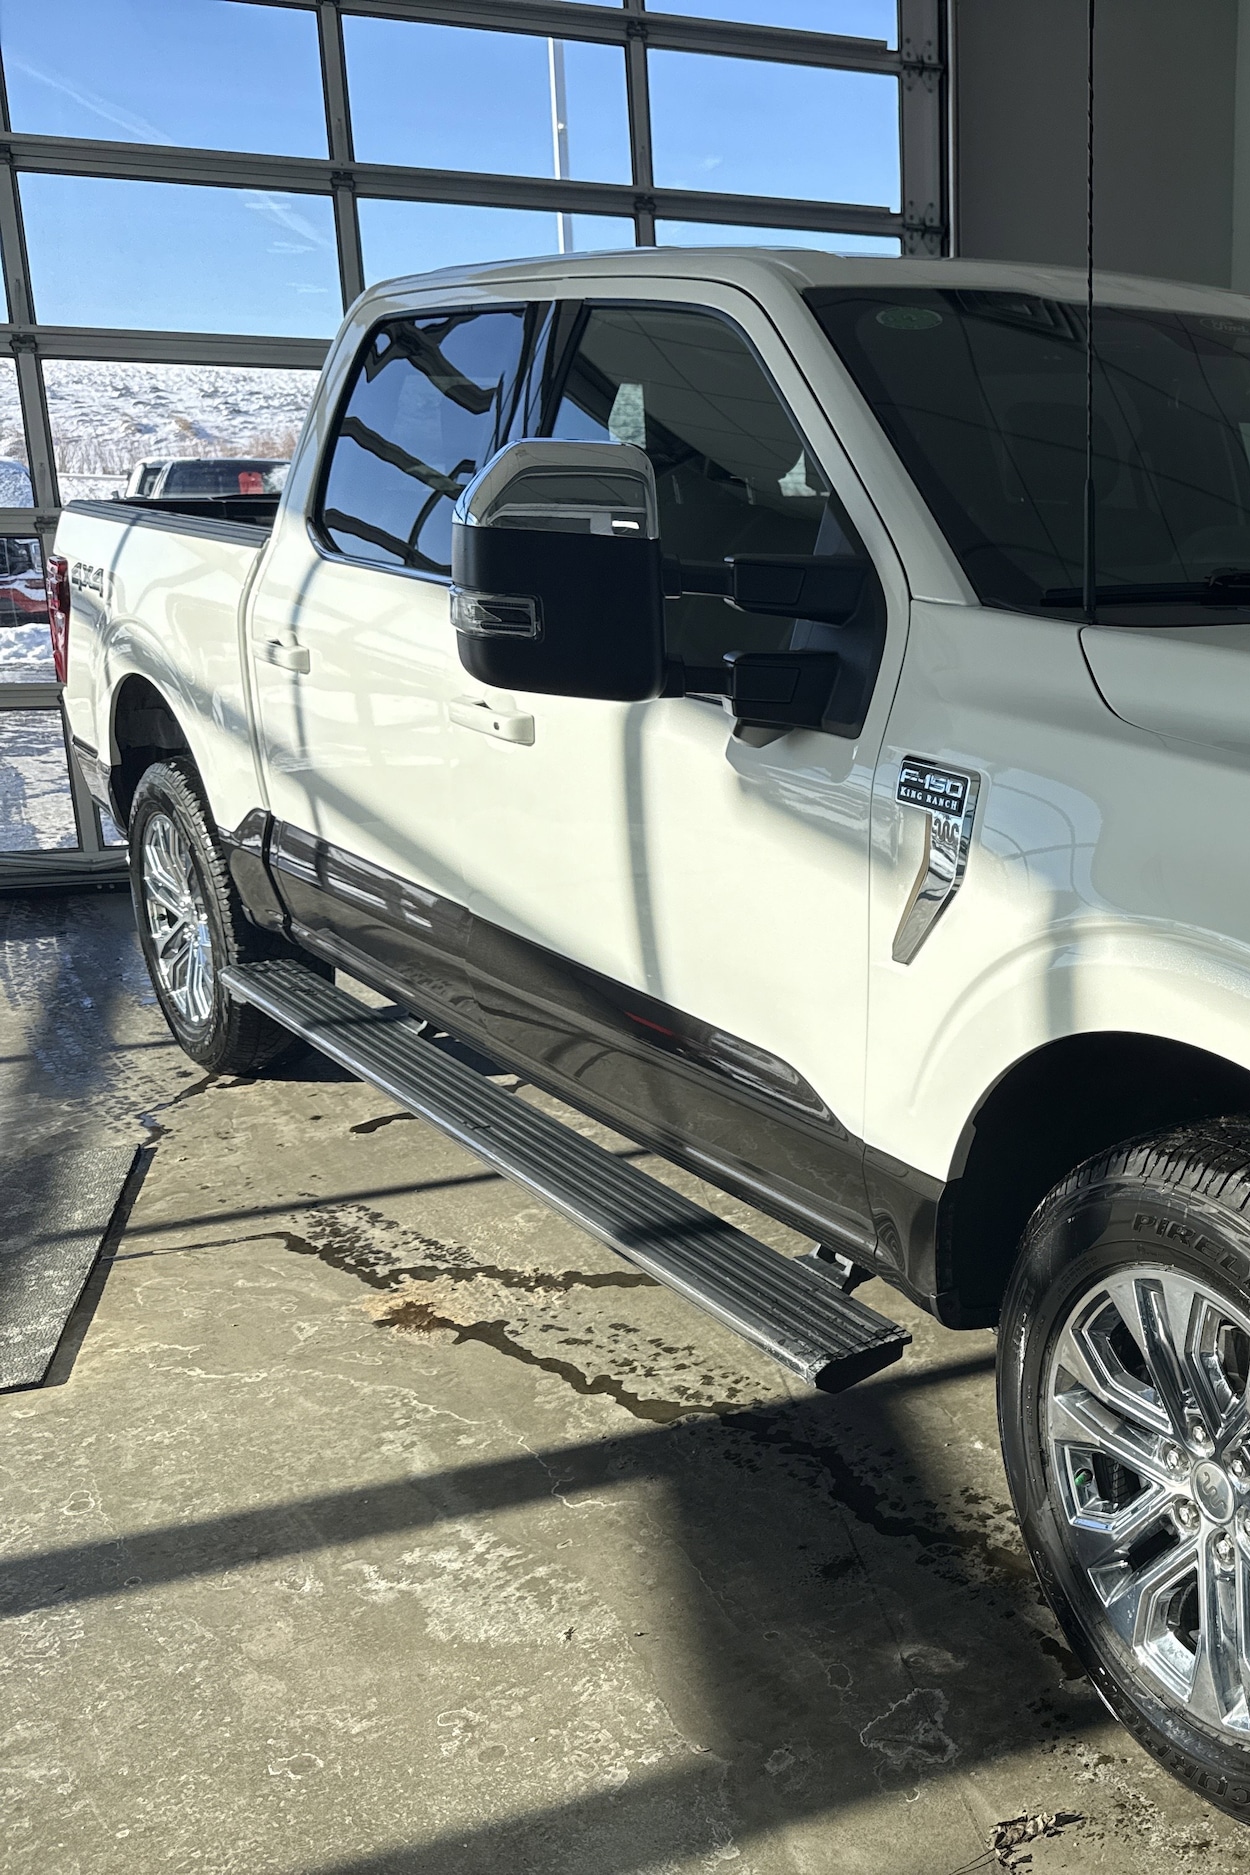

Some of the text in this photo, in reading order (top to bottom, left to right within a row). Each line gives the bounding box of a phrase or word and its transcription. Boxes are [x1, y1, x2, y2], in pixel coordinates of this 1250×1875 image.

[900, 769, 963, 798] F-150
[900, 787, 958, 811] KING RANCH
